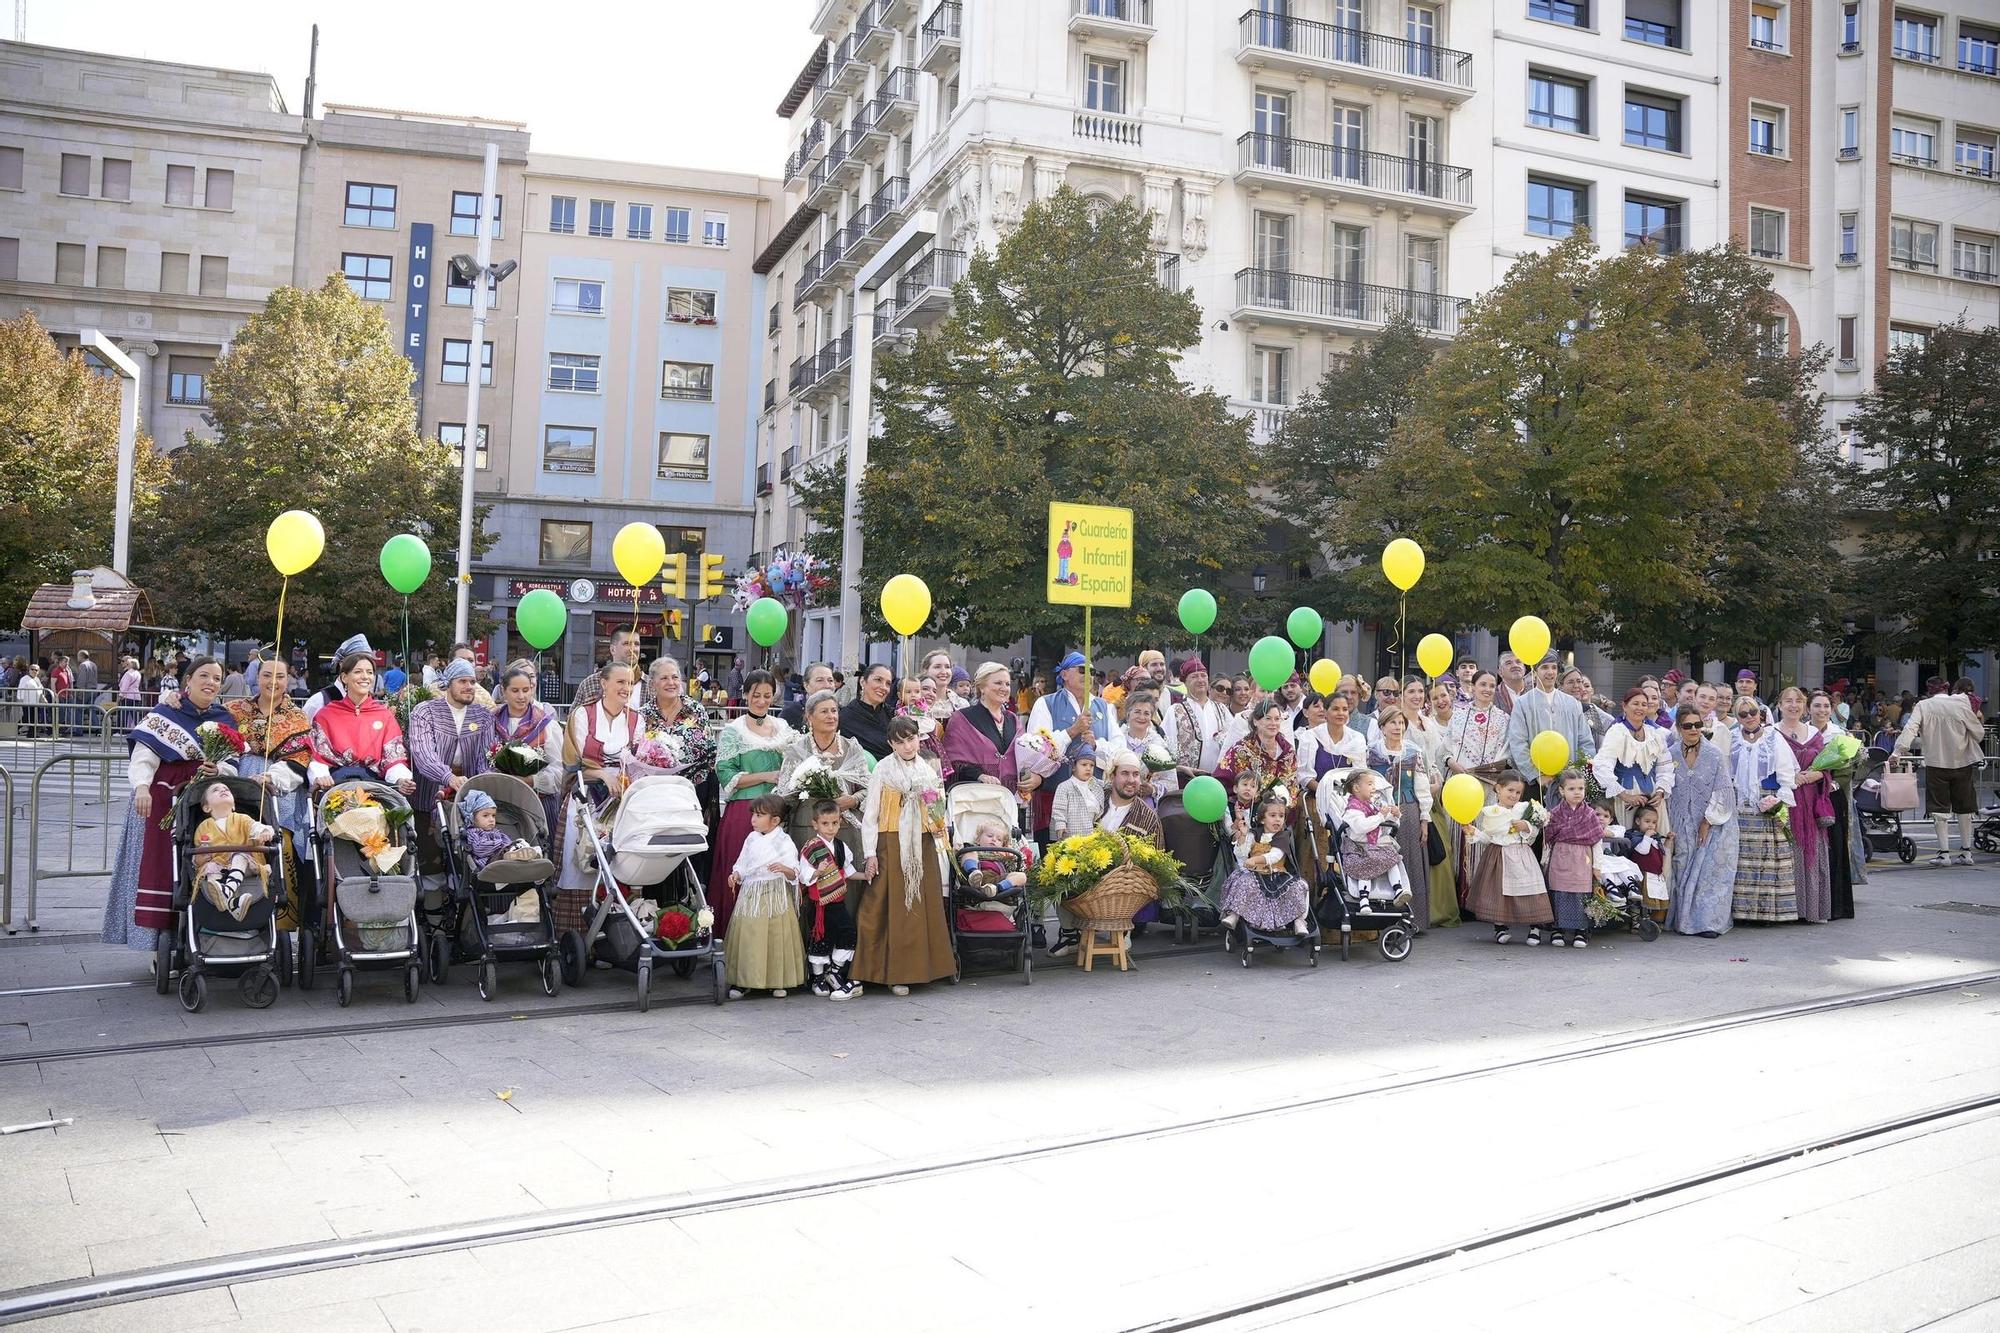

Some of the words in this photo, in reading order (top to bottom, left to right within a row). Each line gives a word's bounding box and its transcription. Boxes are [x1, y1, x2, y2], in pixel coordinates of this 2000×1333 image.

[410, 246, 425, 346] HOTE
[1079, 519, 1128, 539] Guardería
[1083, 547, 1127, 567] Infantil
[608, 588, 624, 597] HOT
[625, 588, 642, 598] POT
[1080, 573, 1126, 595] Español
[715, 632, 723, 643] 6
